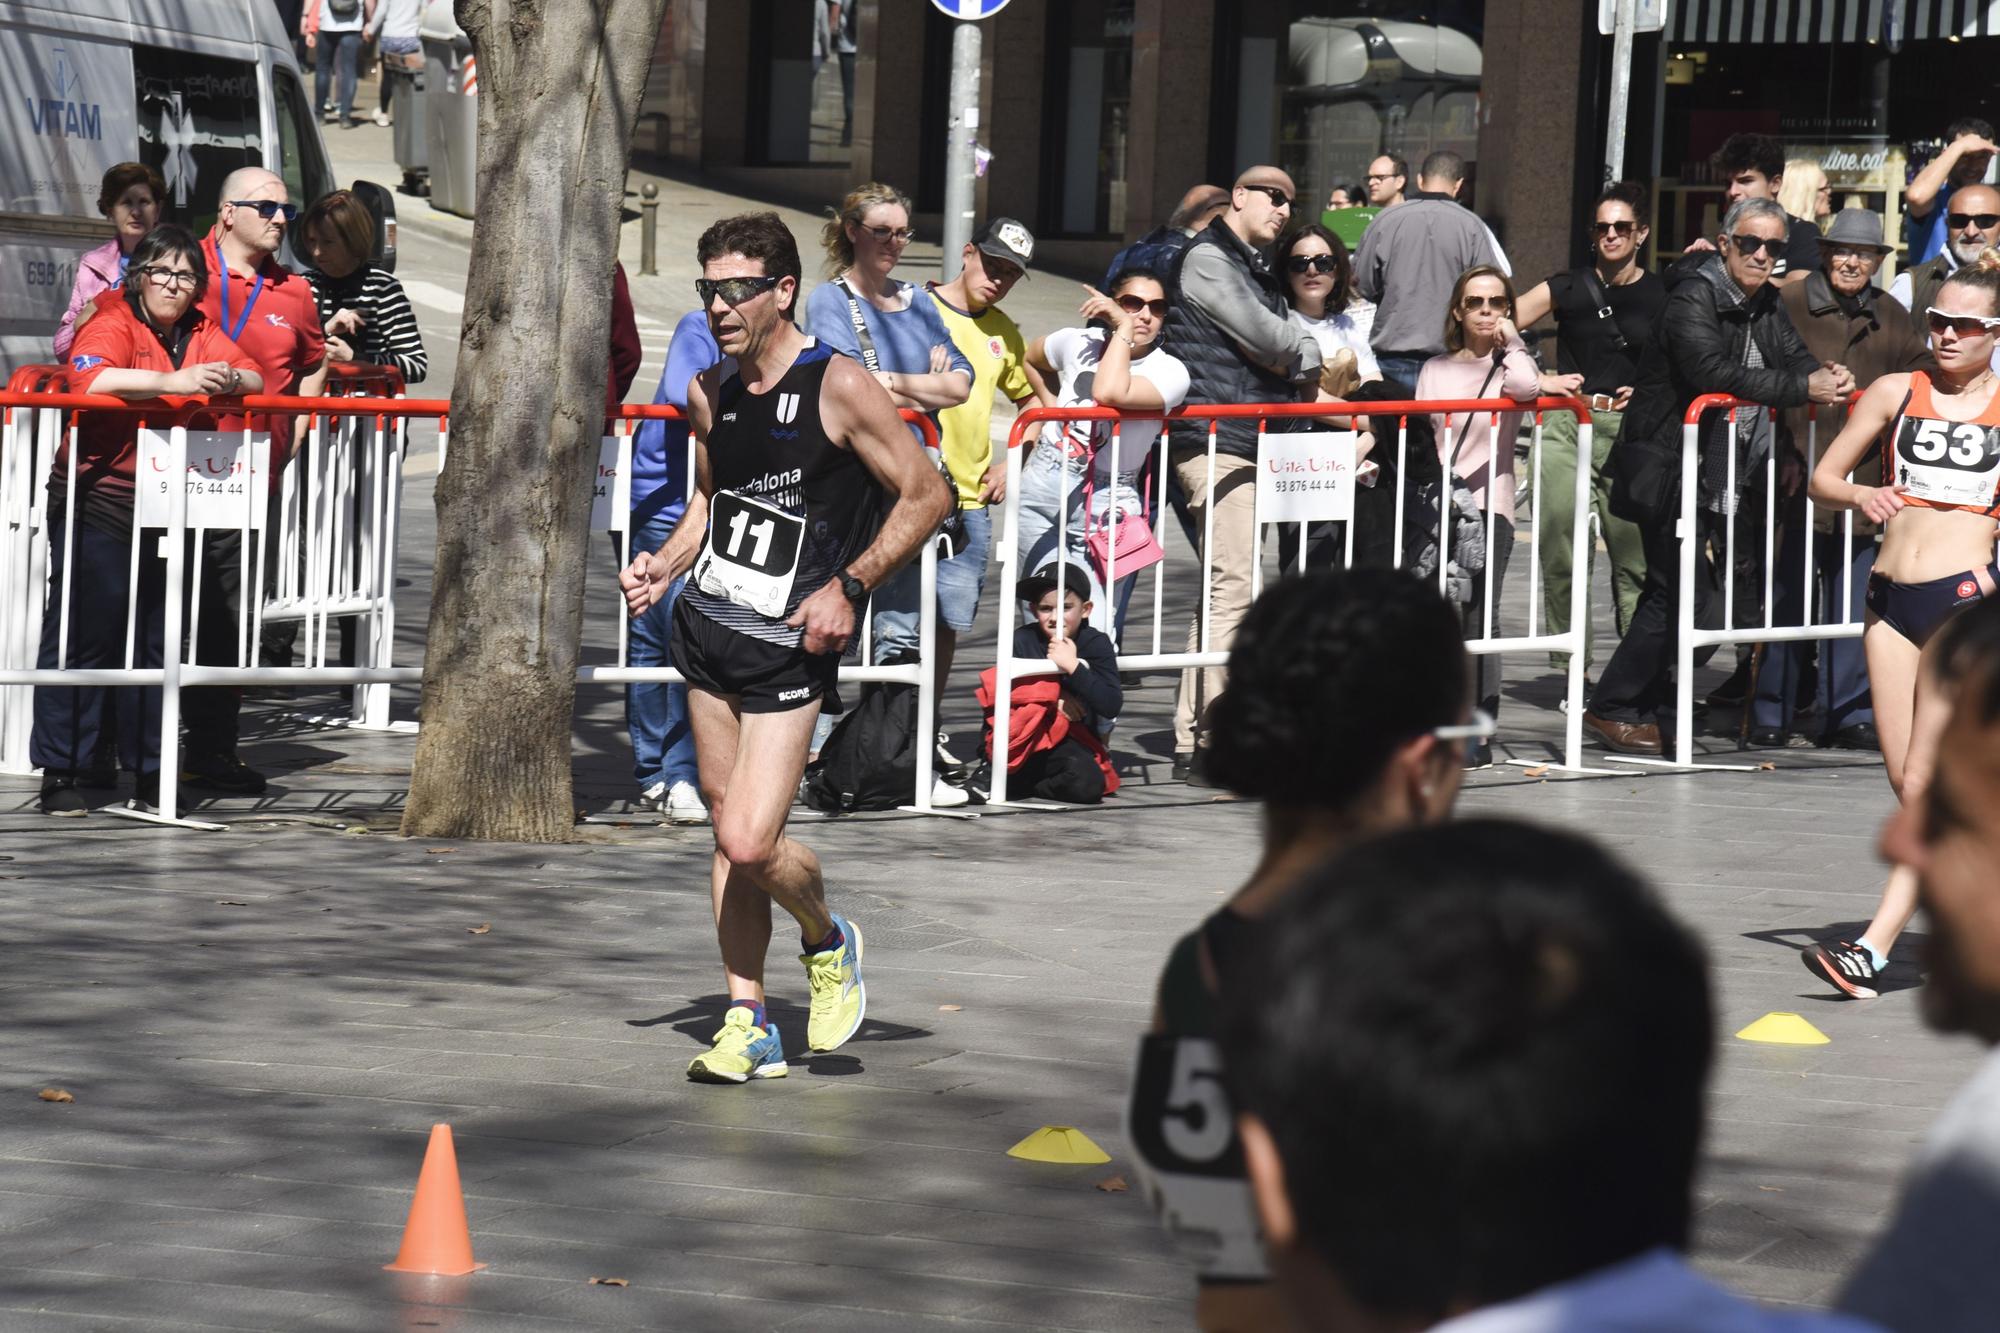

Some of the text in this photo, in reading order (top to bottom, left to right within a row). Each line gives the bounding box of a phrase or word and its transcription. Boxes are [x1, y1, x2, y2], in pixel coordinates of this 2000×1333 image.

[27, 97, 101, 141] VITAM
[863, 348, 881, 375] BIM
[1912, 418, 1985, 467] 53
[207, 483, 223, 495] 44
[227, 483, 243, 495] 44
[1275, 480, 1336, 493] 93 876 44 44
[727, 509, 775, 567] 11
[1160, 1037, 1233, 1164] 5
